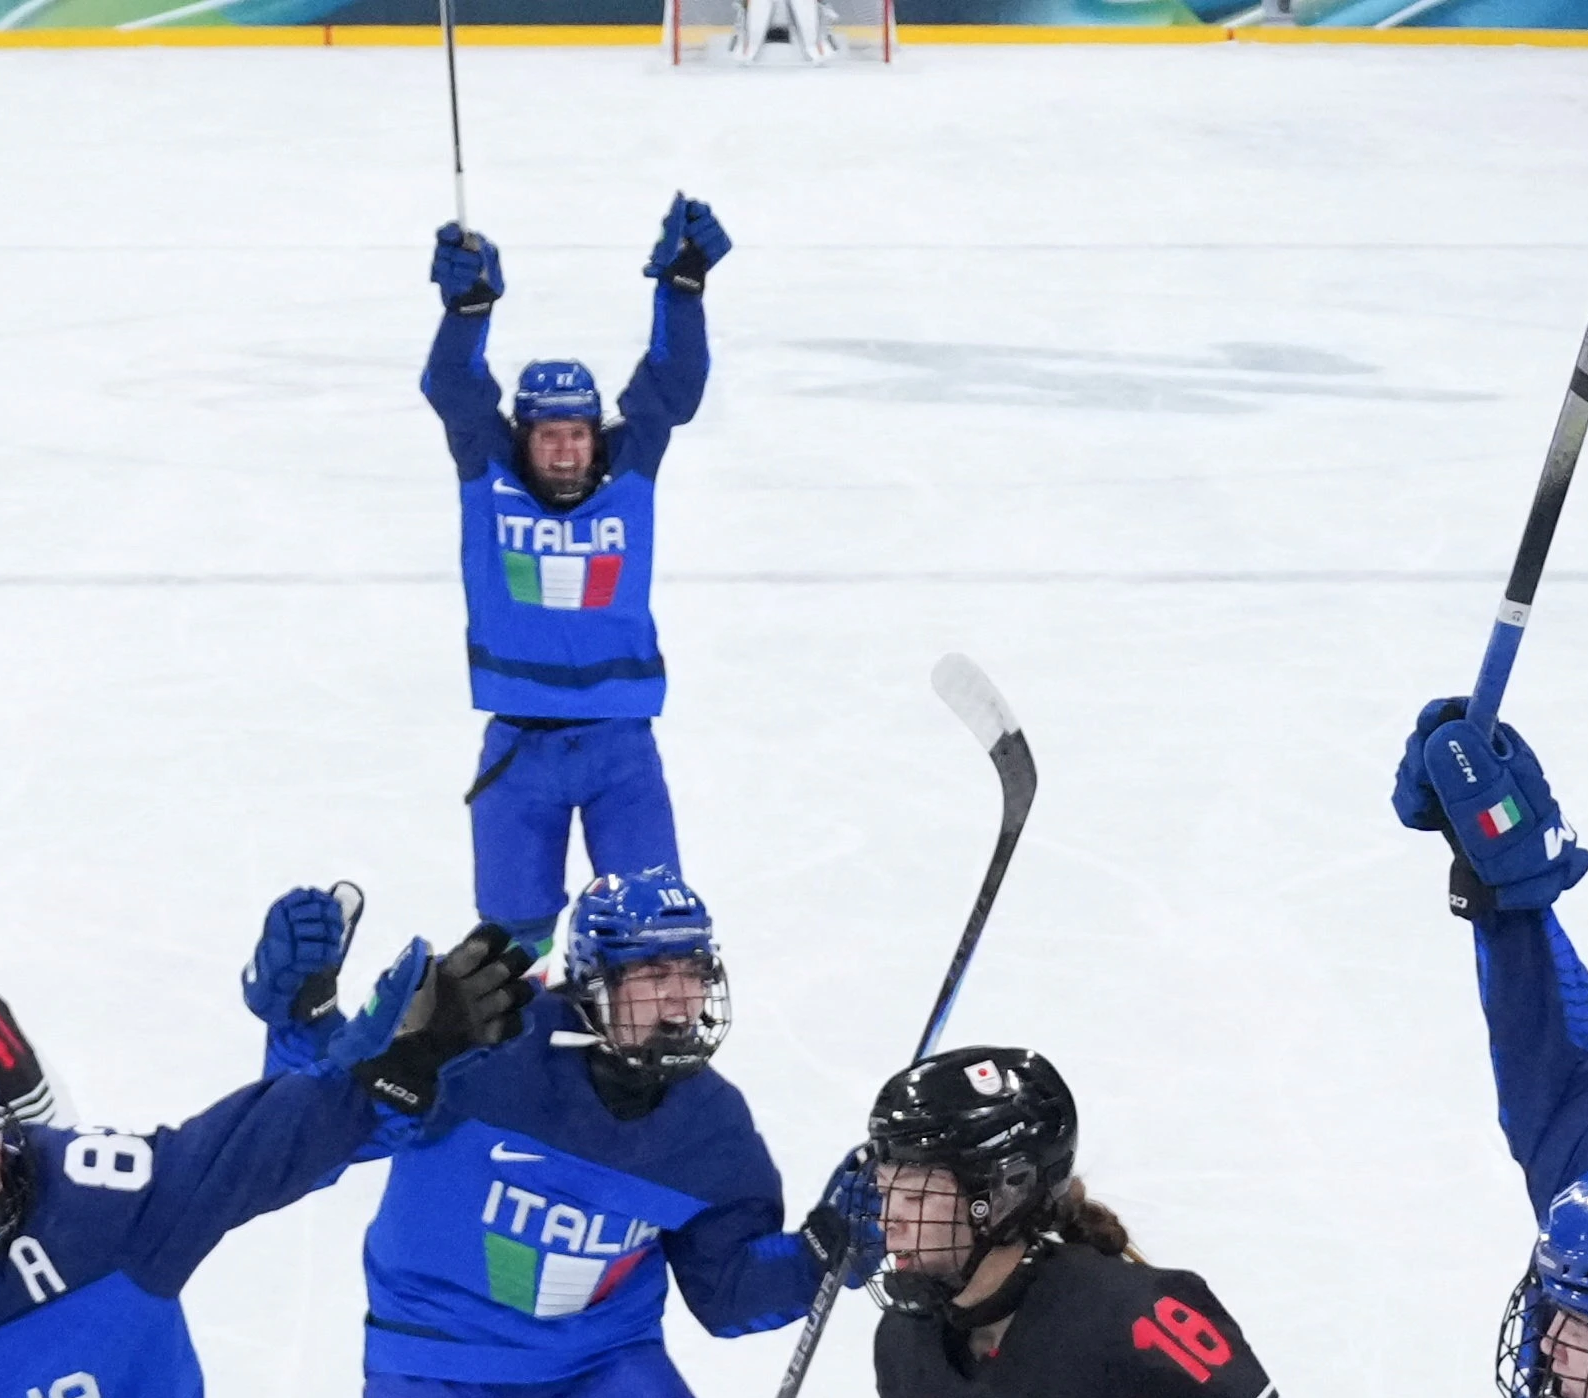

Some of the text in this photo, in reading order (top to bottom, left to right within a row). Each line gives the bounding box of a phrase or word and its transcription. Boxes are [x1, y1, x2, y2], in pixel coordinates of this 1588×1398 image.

[496, 511, 627, 554] ITALIA
[1447, 740, 1477, 784] CCM
[657, 888, 687, 908] 10
[374, 1077, 419, 1104] CCM
[63, 1126, 154, 1192] 8
[8, 1235, 67, 1304] A
[1131, 1295, 1233, 1384] 18
